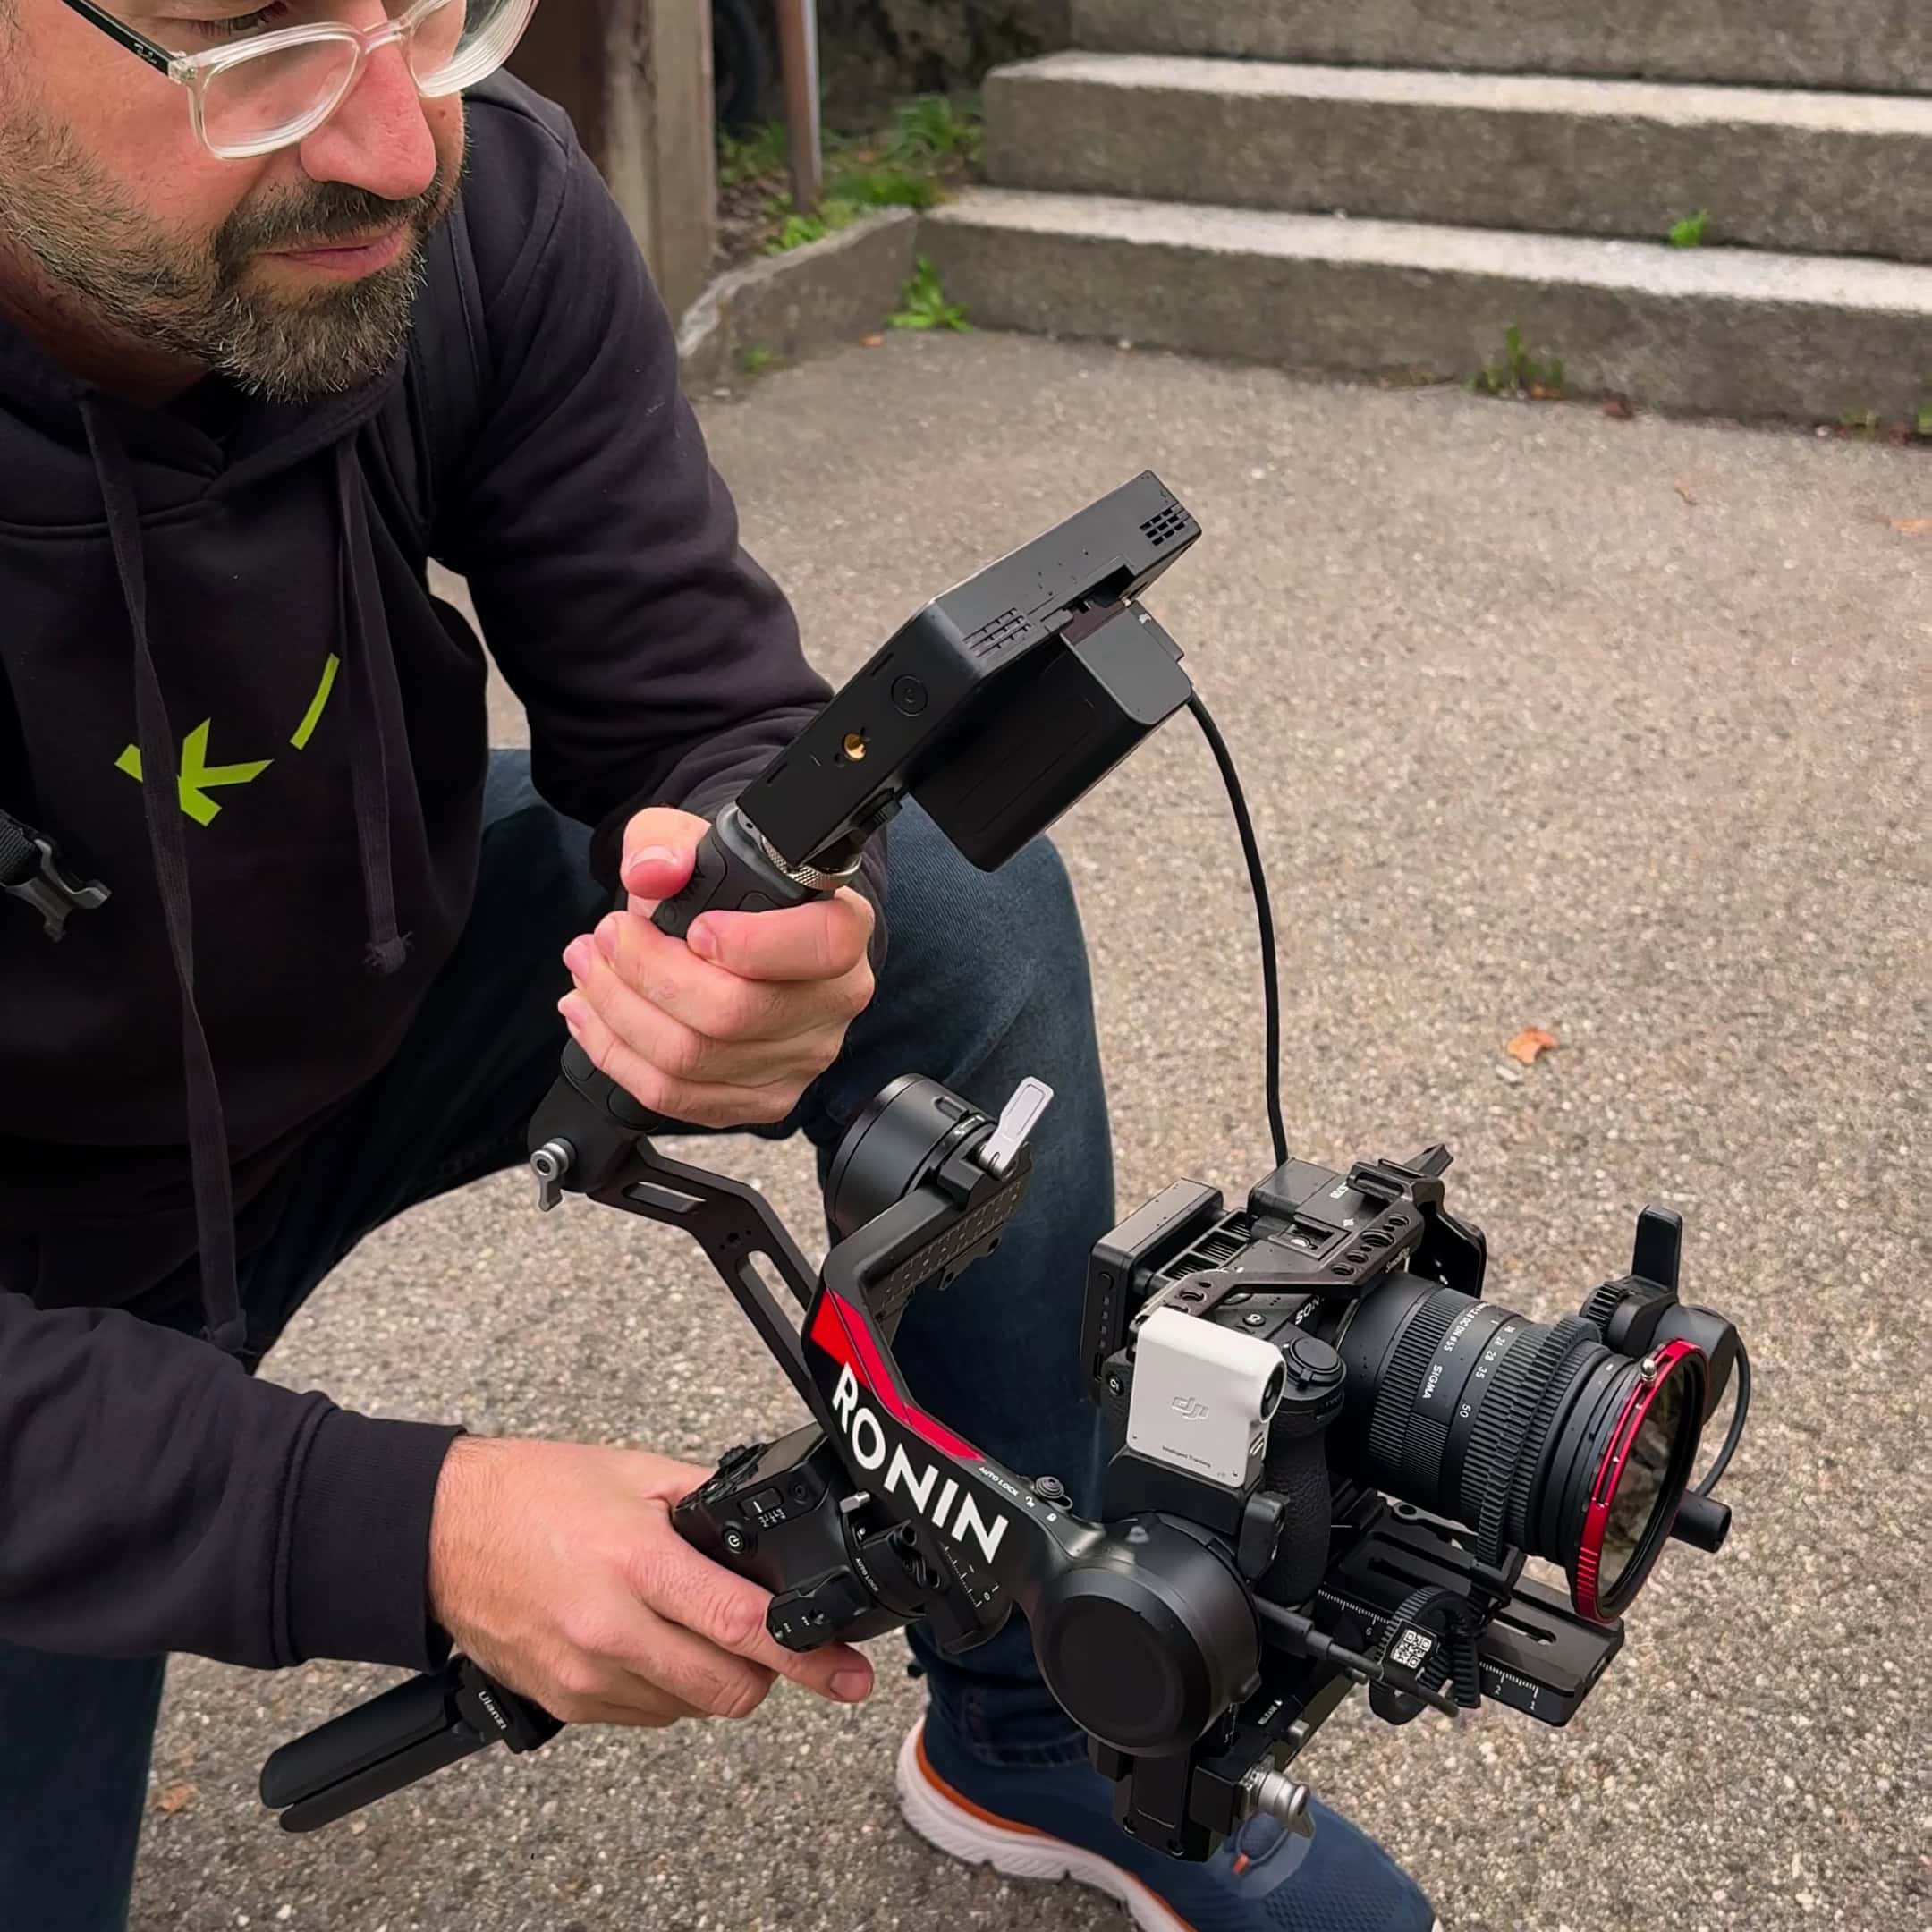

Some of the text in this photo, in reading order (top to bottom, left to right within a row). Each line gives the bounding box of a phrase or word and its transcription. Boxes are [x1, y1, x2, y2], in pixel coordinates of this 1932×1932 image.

[1294, 1296, 1326, 1326] SON
[1421, 1364, 1443, 1399] SIGMA
[1475, 1365, 1487, 1378] 35
[1459, 1403, 1471, 1418] 50
[832, 1360, 1009, 1564] RONIN
[978, 1467, 1019, 1496] AUTO LOCK
[1495, 1685, 1503, 1695] 2
[478, 1690, 507, 1730] Ulanzi
